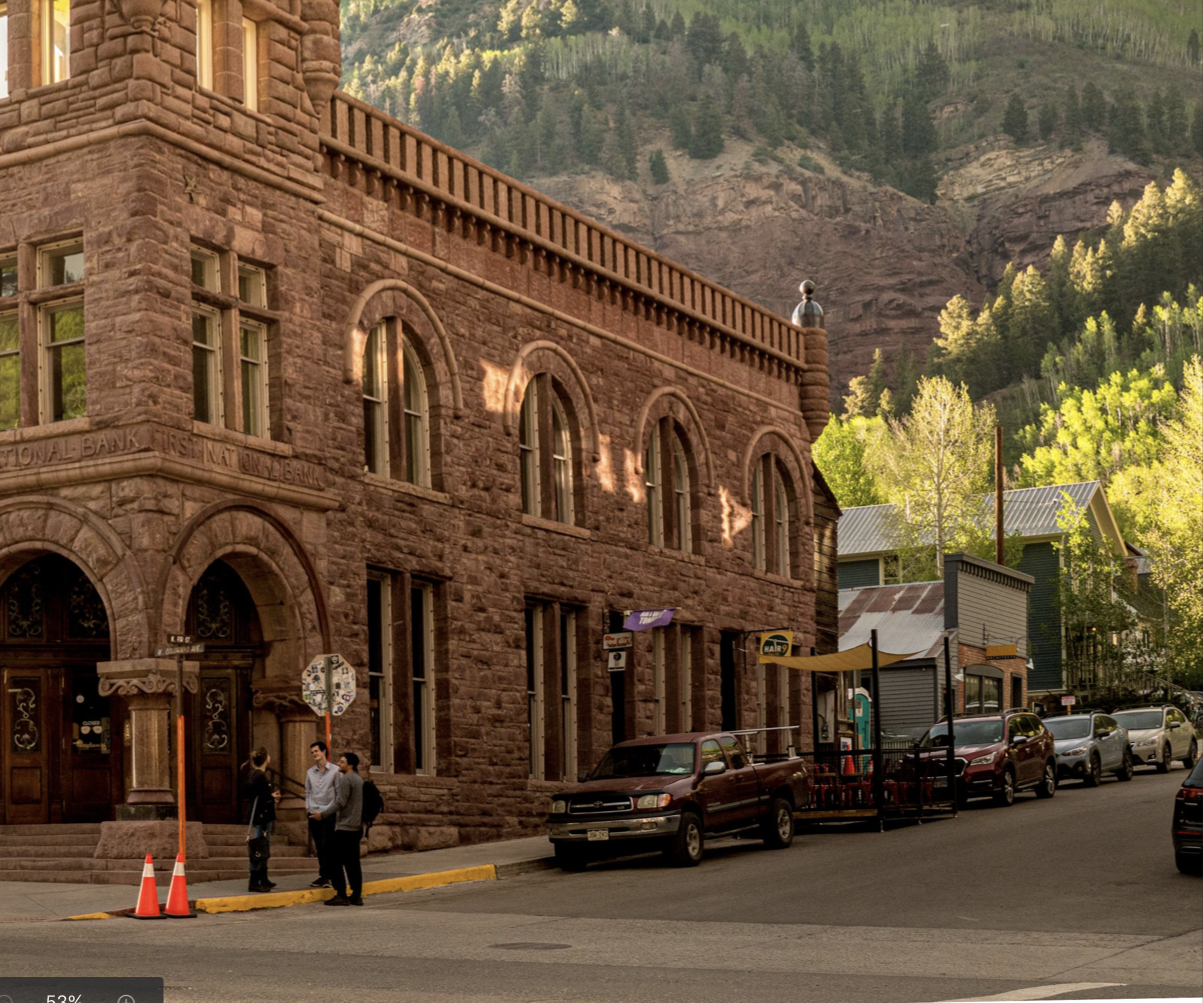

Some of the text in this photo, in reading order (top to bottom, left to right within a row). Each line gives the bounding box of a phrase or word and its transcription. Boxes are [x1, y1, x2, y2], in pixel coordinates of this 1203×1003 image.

[81, 427, 139, 457] BANK
[152, 428, 321, 487] FIRST NATIONAL BANK
